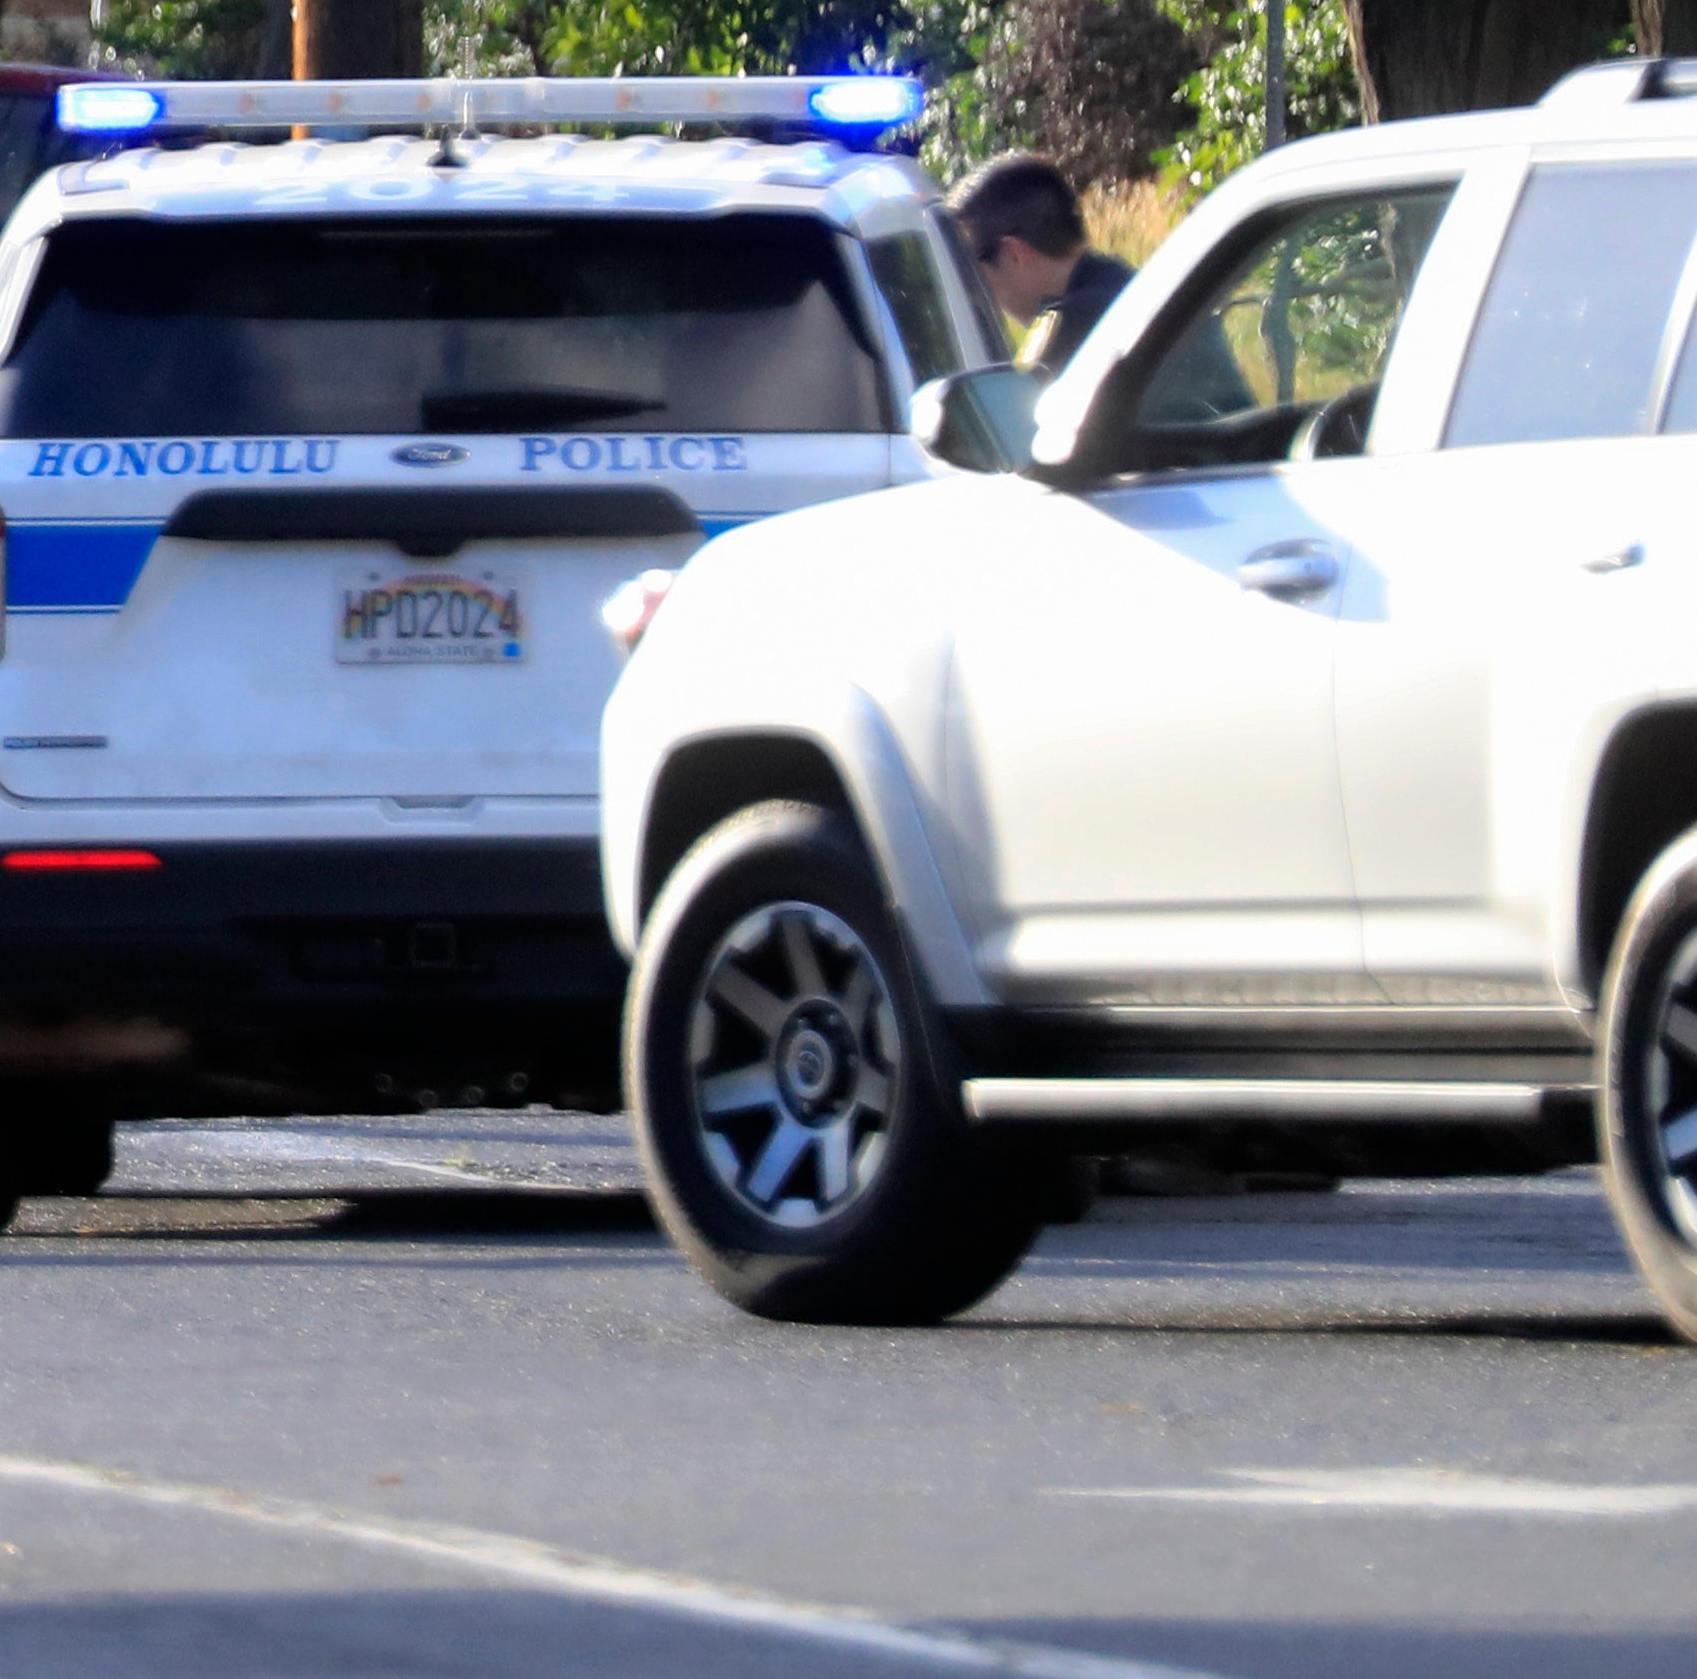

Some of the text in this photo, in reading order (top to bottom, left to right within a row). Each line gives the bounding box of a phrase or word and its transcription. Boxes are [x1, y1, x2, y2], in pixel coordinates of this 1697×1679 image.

[27, 436, 748, 477] HONOLULU POLICE
[344, 588, 521, 639] HPD2024
